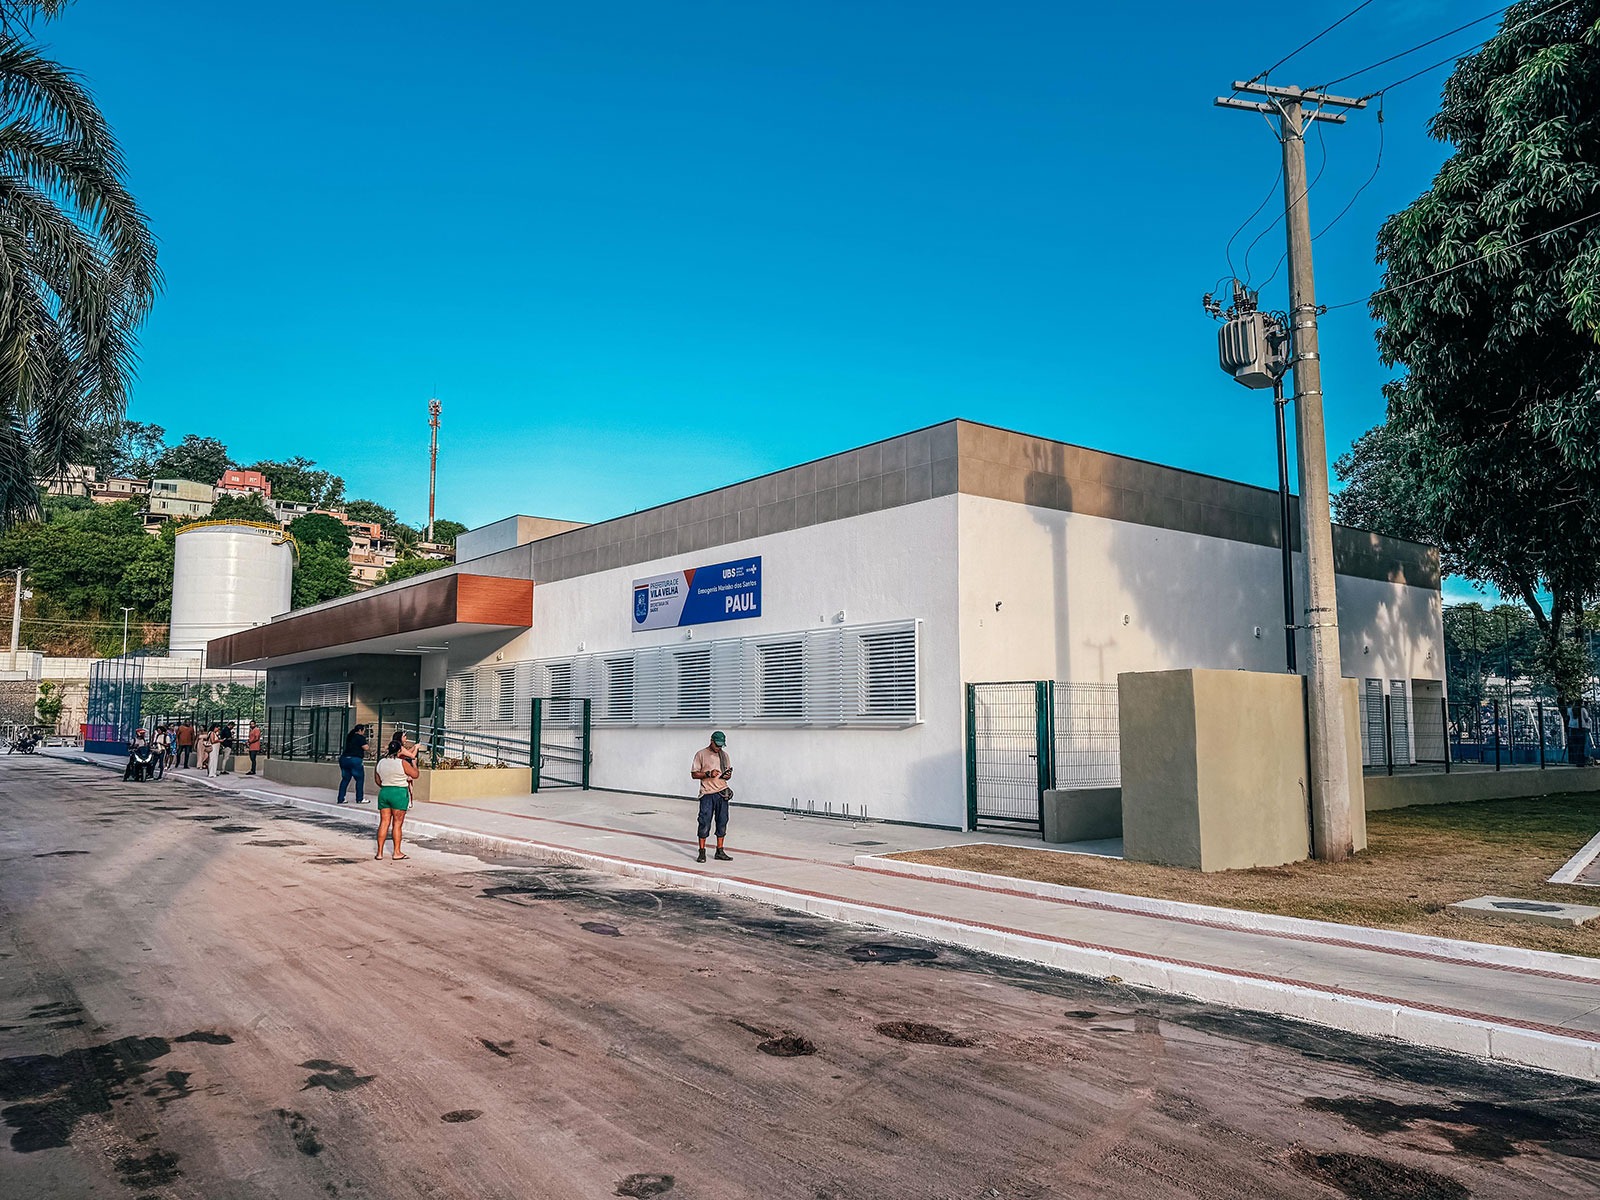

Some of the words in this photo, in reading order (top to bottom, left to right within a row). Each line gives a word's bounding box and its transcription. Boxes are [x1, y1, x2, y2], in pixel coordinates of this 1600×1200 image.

[723, 568, 736, 579] UBS
[650, 588, 662, 598] VILA
[662, 586, 678, 596] VELHA
[725, 592, 757, 613] PAUL
